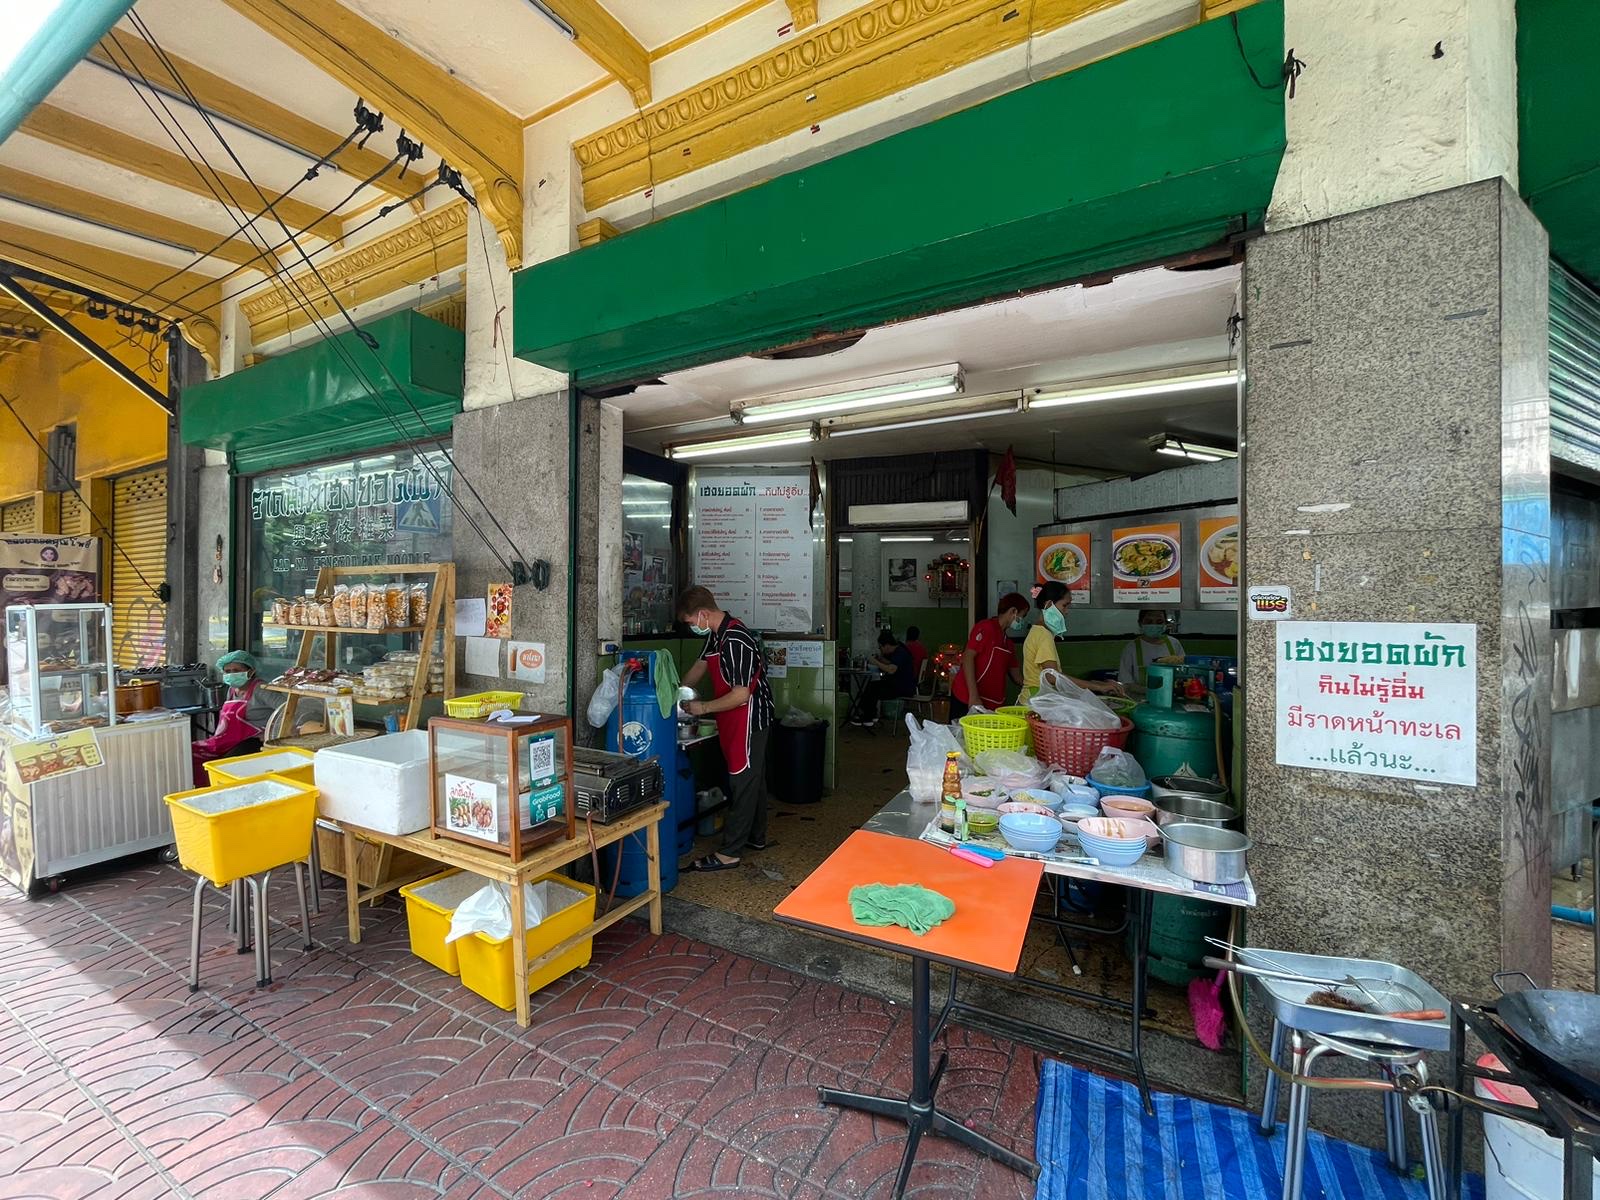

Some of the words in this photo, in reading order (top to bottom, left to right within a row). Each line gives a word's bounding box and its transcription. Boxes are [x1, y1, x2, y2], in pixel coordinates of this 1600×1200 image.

[700, 482, 756, 497] เฮงยอดผัก
[1284, 631, 1467, 668] เฮงยอดผัก
[1318, 672, 1425, 704] กินไม่รู้อิ่ม
[1287, 705, 1462, 741] มีราดหน้าทะเล
[532, 790, 561, 806] GrabFood
